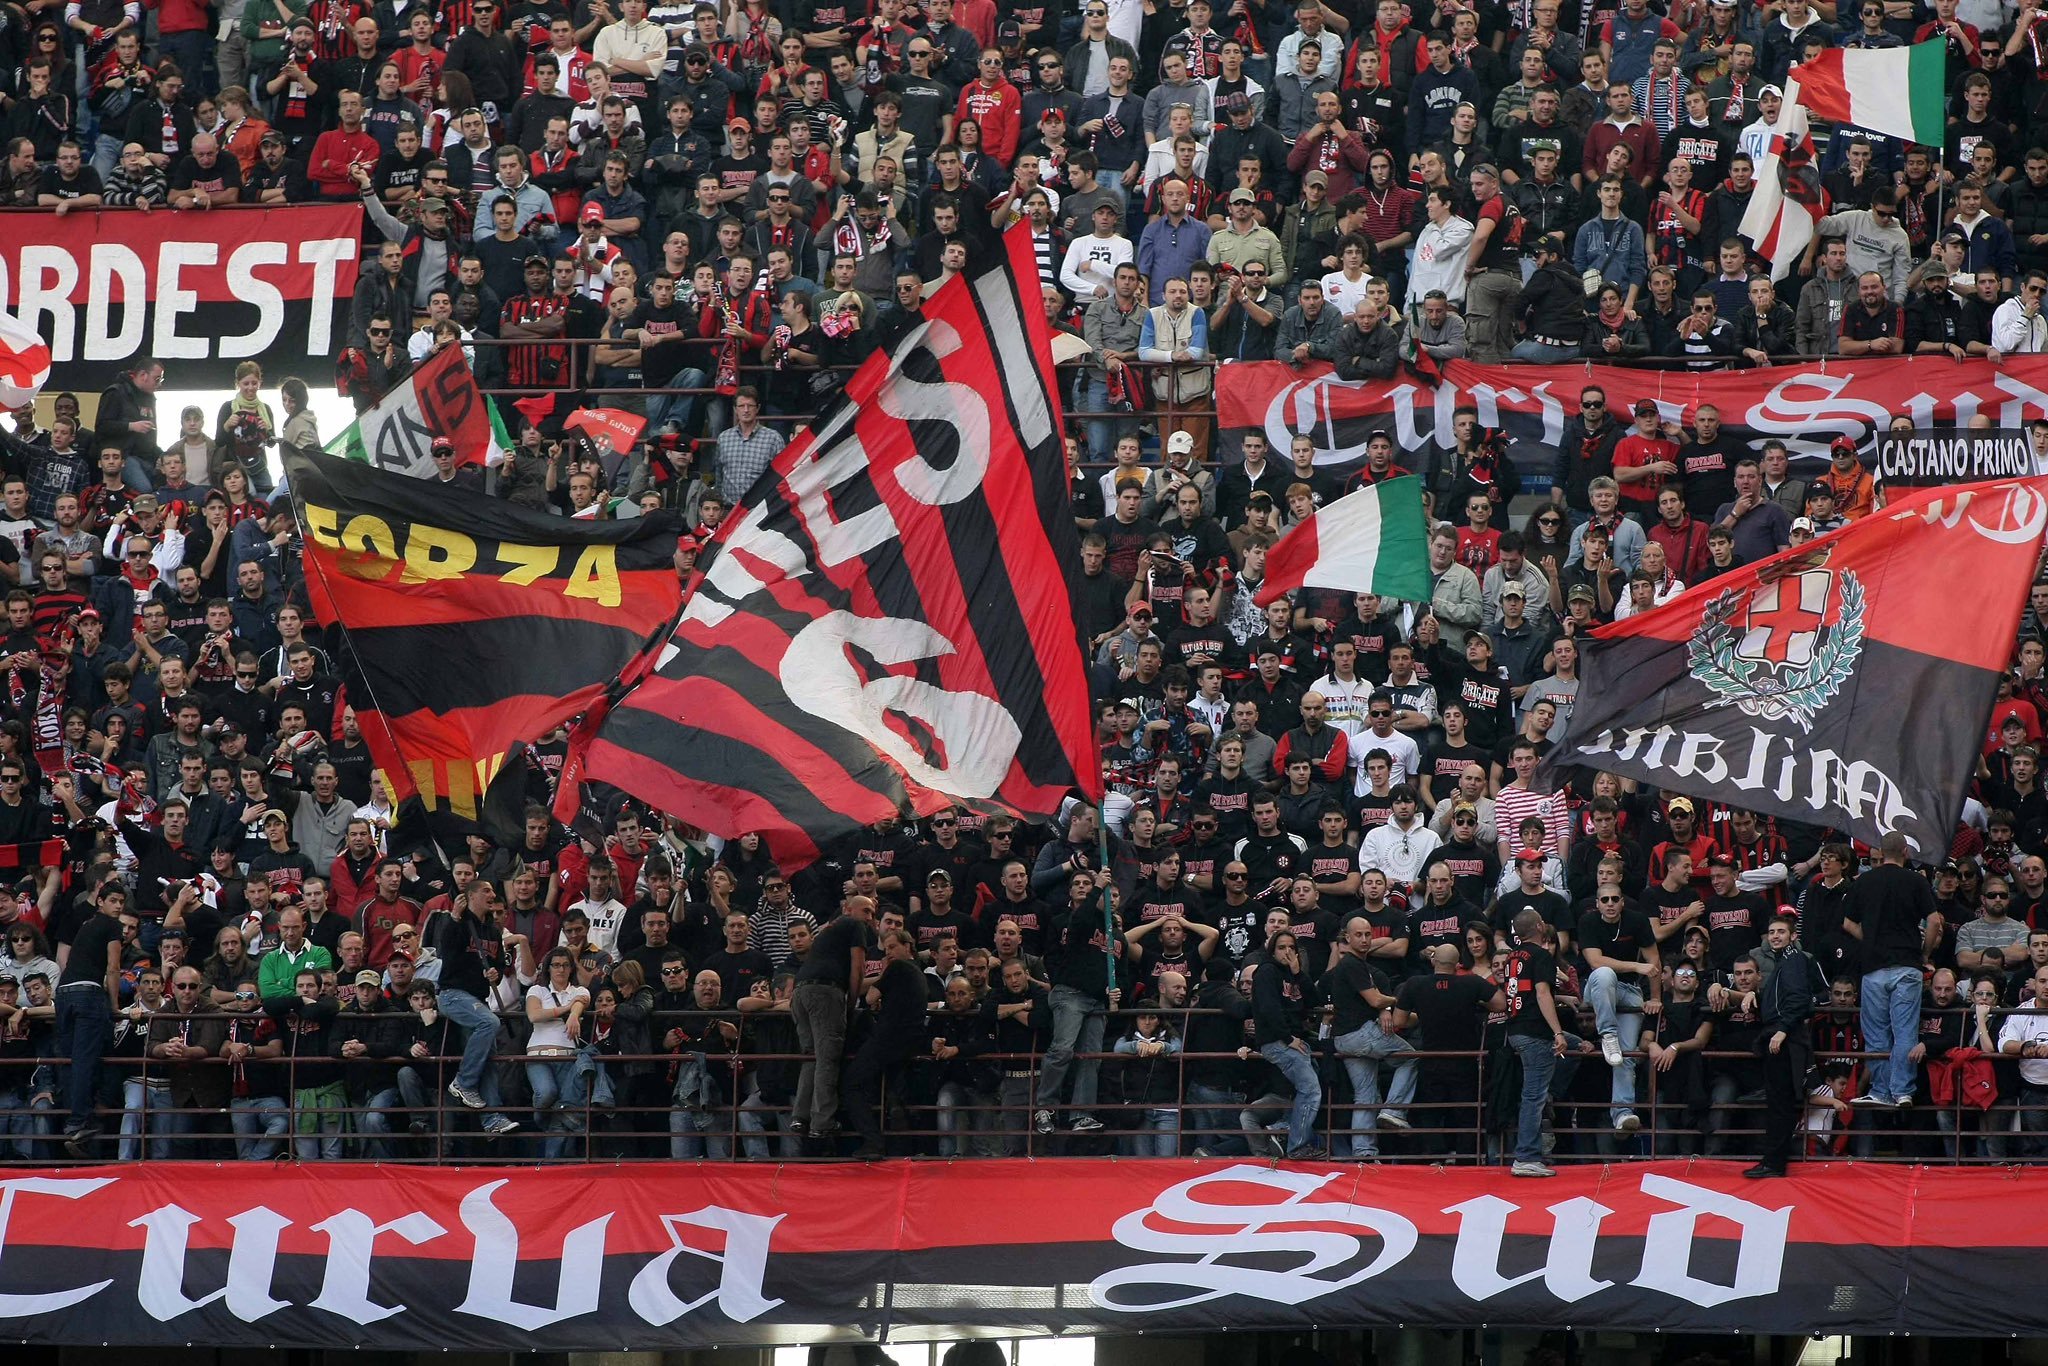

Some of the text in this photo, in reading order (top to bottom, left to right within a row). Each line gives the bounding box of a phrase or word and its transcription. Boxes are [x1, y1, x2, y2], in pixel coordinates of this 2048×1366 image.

[1678, 138, 1719, 160] BRIGATE
[0, 238, 356, 361] RDEST
[1265, 372, 1688, 466] Cur
[1684, 455, 1725, 471] CURVASUD
[1882, 437, 2029, 477] CASTANO PRIMO
[305, 502, 623, 608] FORZA
[1461, 677, 1500, 707] BRIGATE
[1312, 858, 1350, 872] CURVASUD
[1709, 909, 1750, 927] CURVASUD
[1090, 1164, 1796, 1313] Sud
